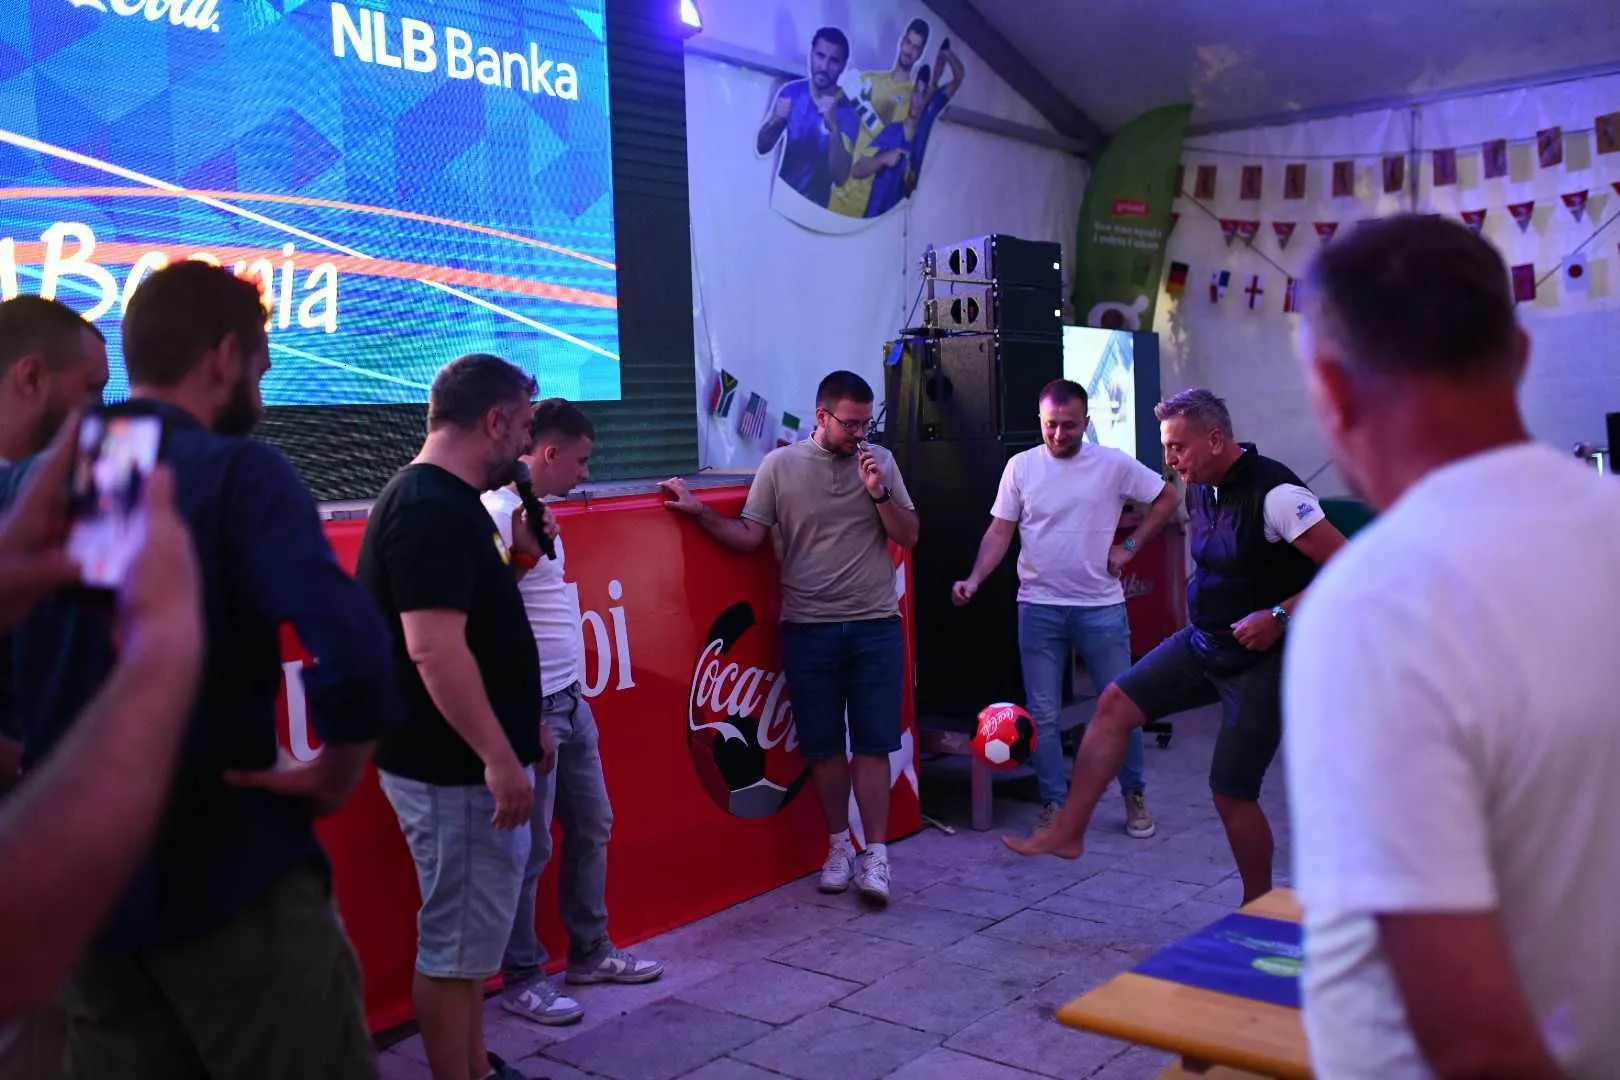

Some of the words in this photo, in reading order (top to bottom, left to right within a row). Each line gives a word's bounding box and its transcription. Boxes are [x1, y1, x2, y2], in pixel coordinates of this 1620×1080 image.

[331, 2, 437, 73] NLB
[446, 26, 579, 101] Banka
[40, 221, 338, 333] Bnia
[690, 638, 799, 752] Coca-C
